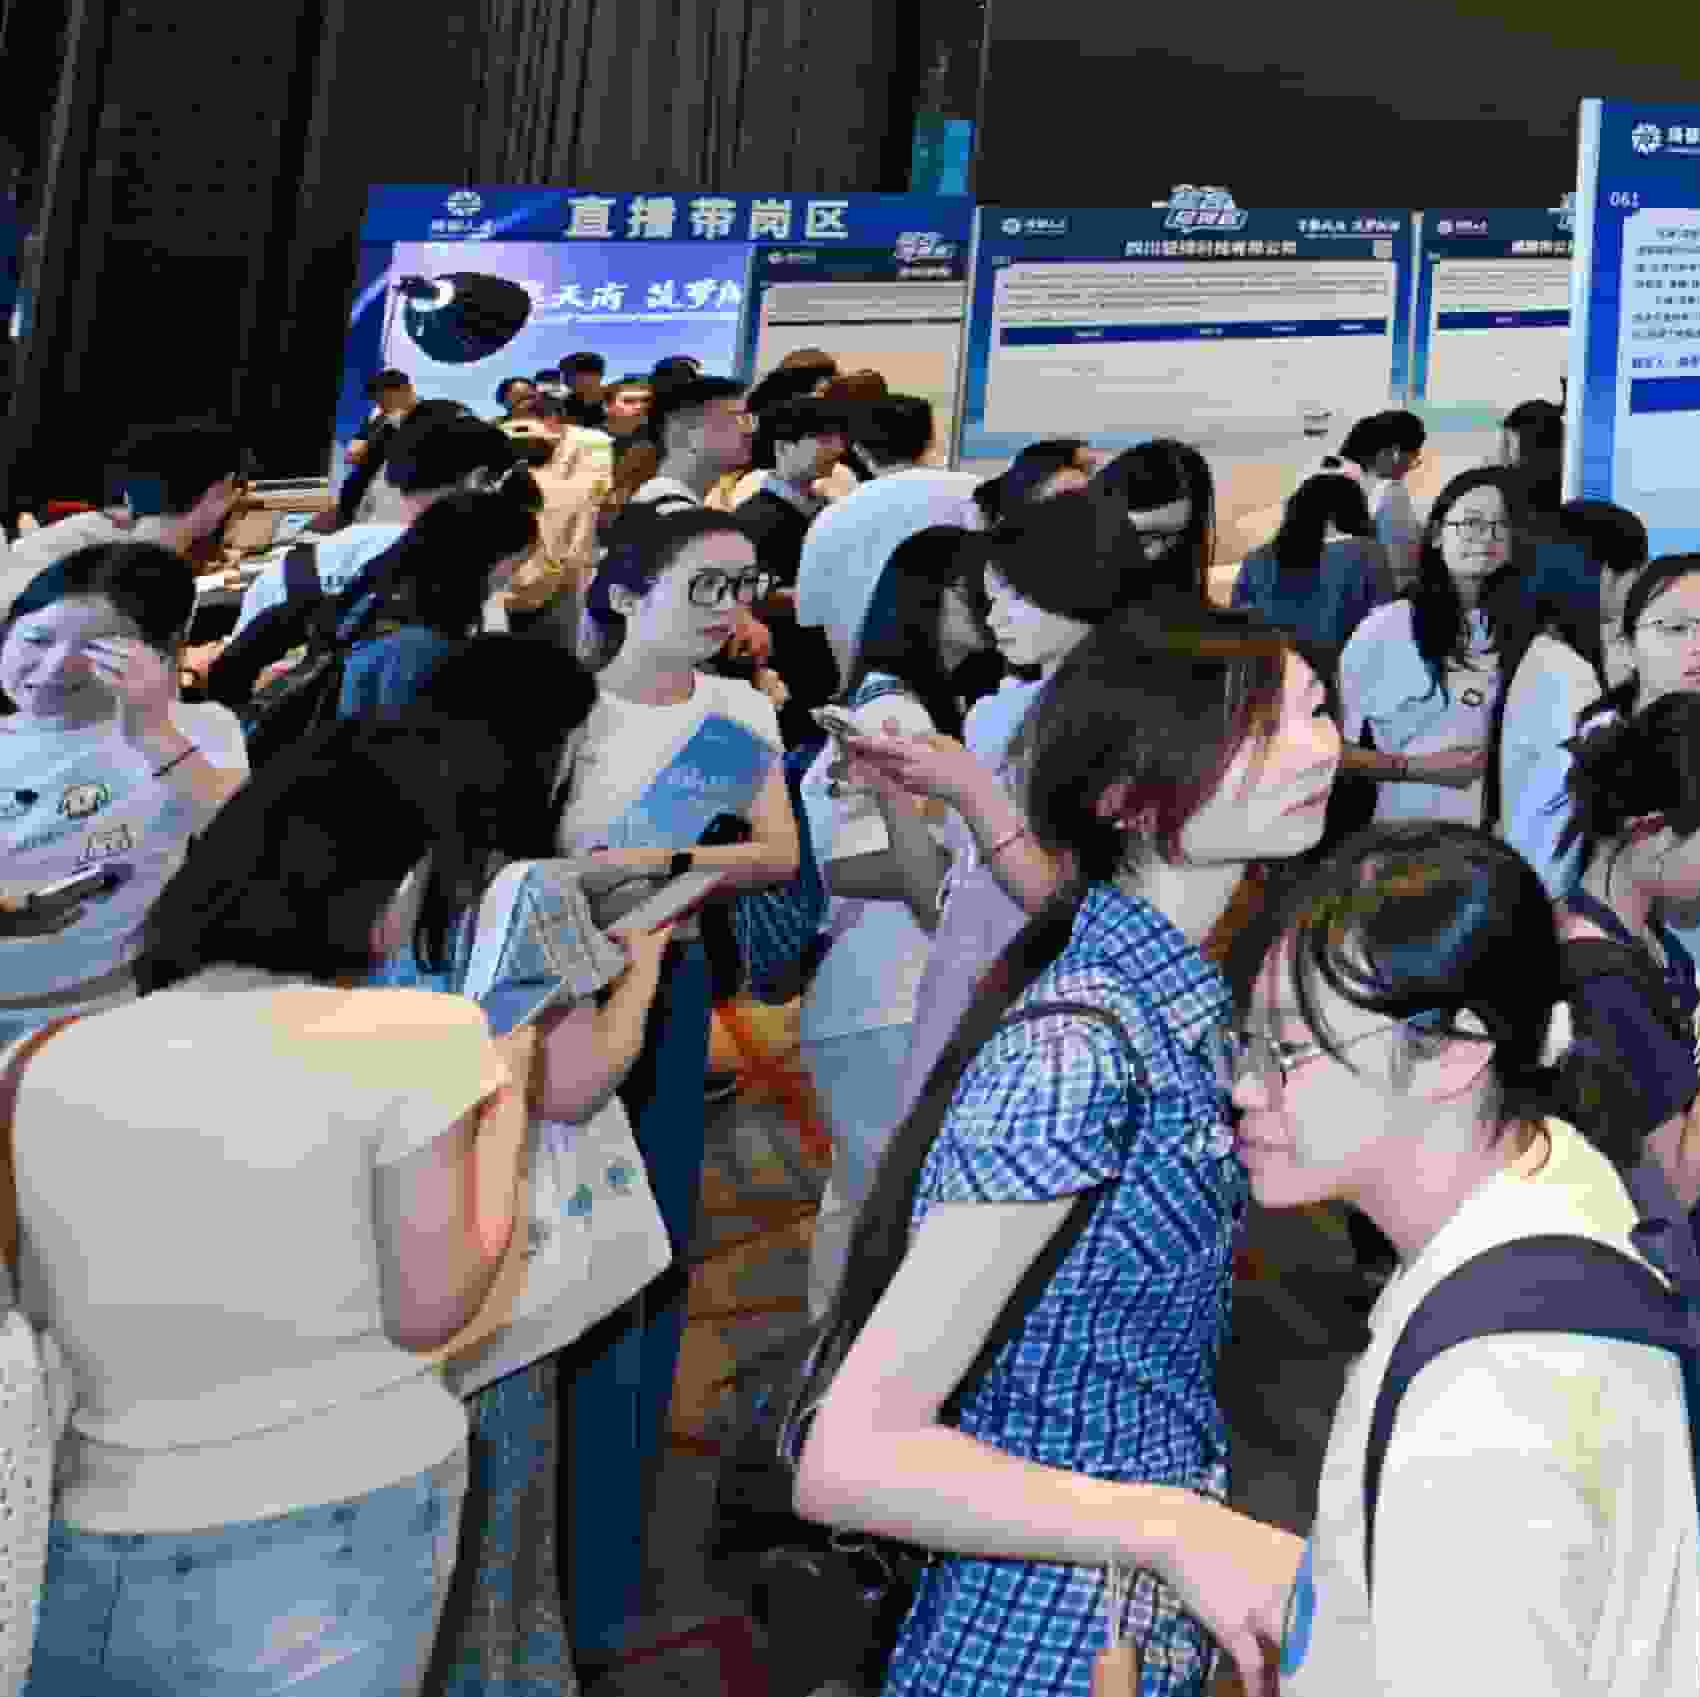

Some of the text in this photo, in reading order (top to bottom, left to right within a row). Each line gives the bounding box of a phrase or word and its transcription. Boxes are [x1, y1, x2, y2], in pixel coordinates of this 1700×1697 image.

[563, 195, 849, 240] 直播带岗区
